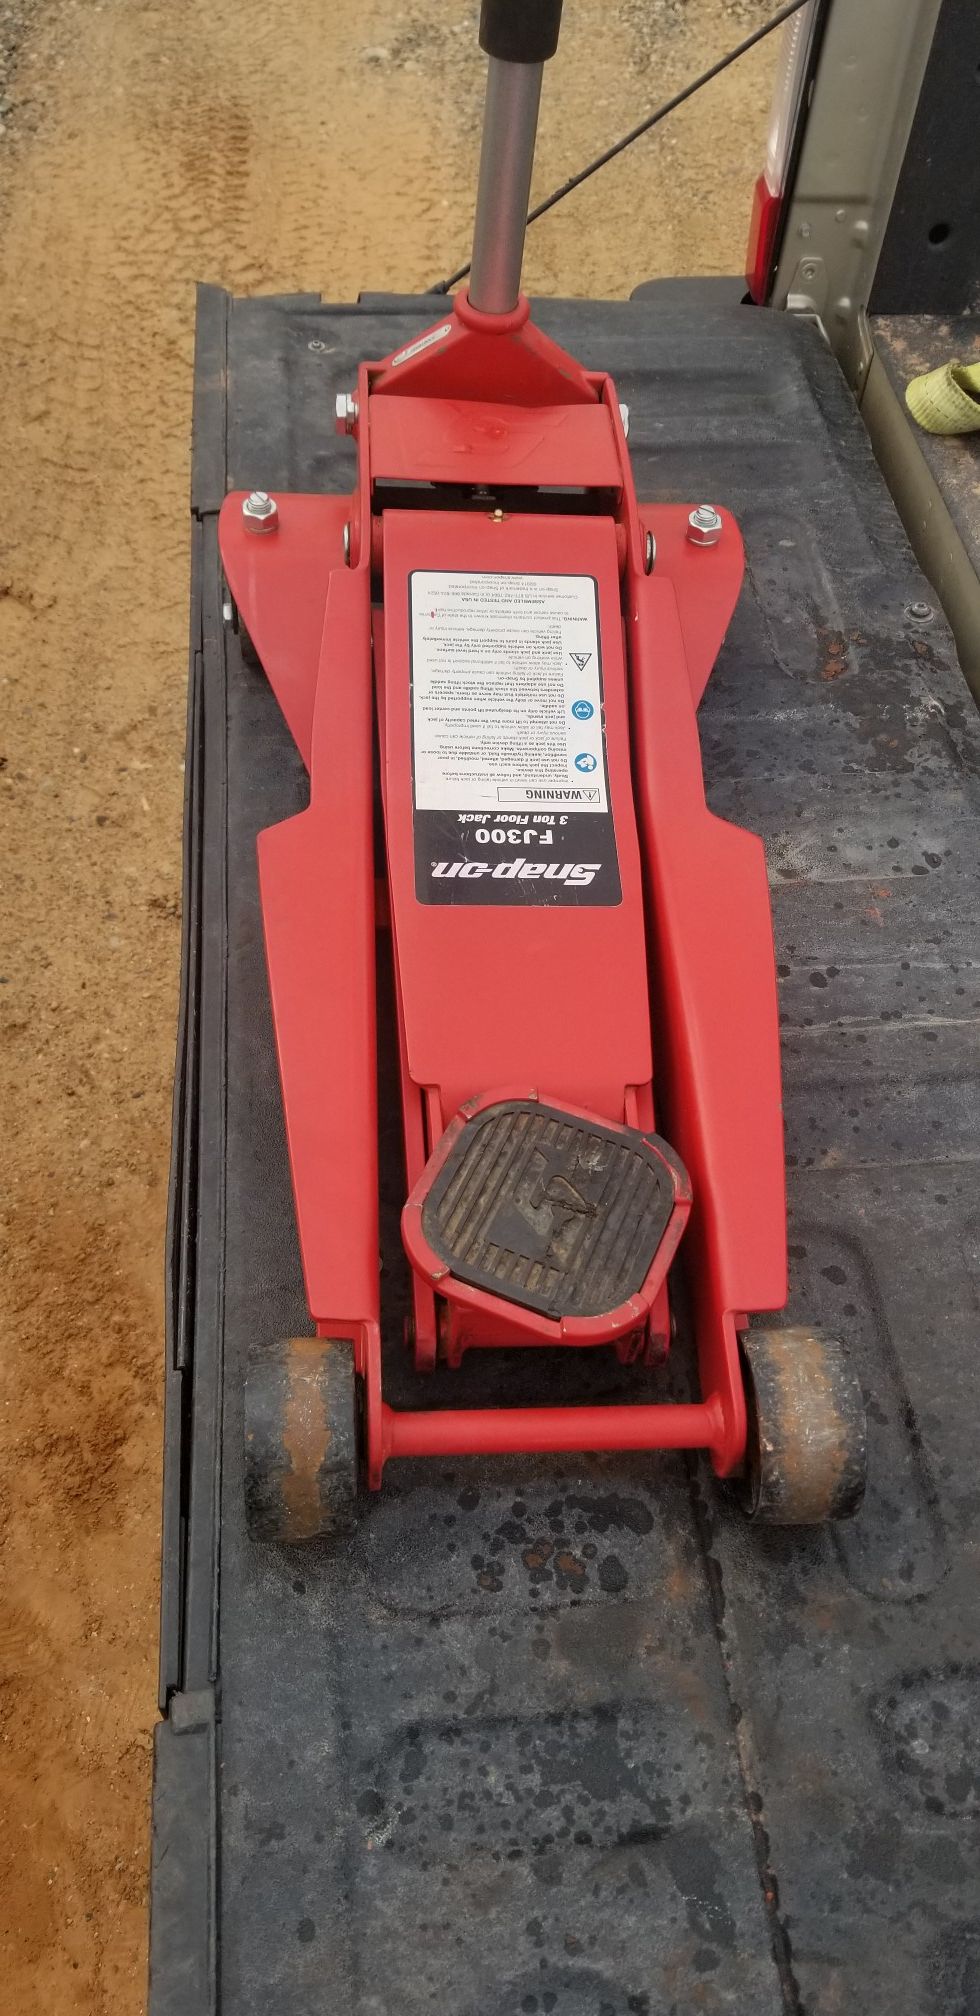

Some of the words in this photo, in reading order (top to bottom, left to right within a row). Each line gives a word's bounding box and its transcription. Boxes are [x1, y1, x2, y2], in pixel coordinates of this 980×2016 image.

[526, 789, 583, 800] WARNING
[457, 813, 491, 824] Jack
[493, 814, 529, 825] Floor
[533, 815, 556, 825] Ton
[560, 815, 569, 825] 3
[475, 828, 554, 845] FJ300
